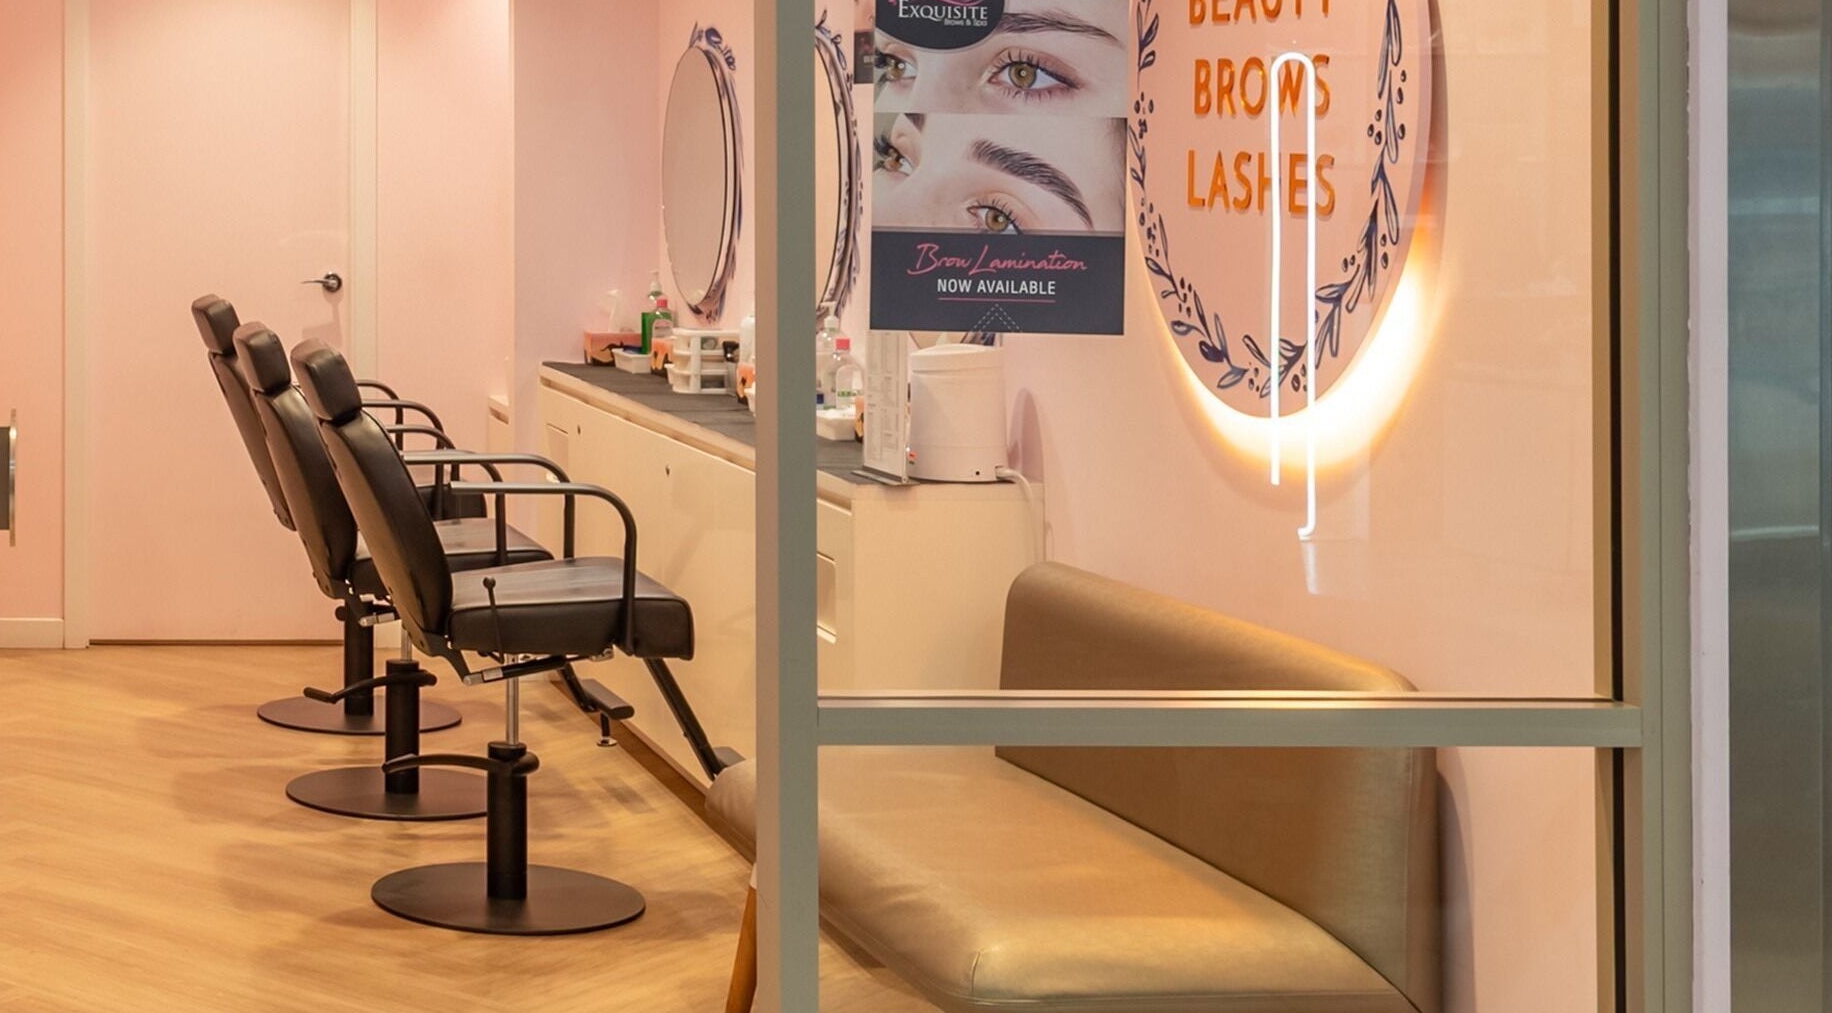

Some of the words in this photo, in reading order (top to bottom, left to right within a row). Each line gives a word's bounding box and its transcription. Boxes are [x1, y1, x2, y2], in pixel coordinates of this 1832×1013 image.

[1193, 54, 1331, 116] BROWS
[1185, 149, 1337, 216] LASHES
[906, 243, 972, 275] Brow
[968, 244, 1087, 273] Lamination
[937, 278, 971, 294] NOW
[976, 279, 1056, 295] AVAILABLE
